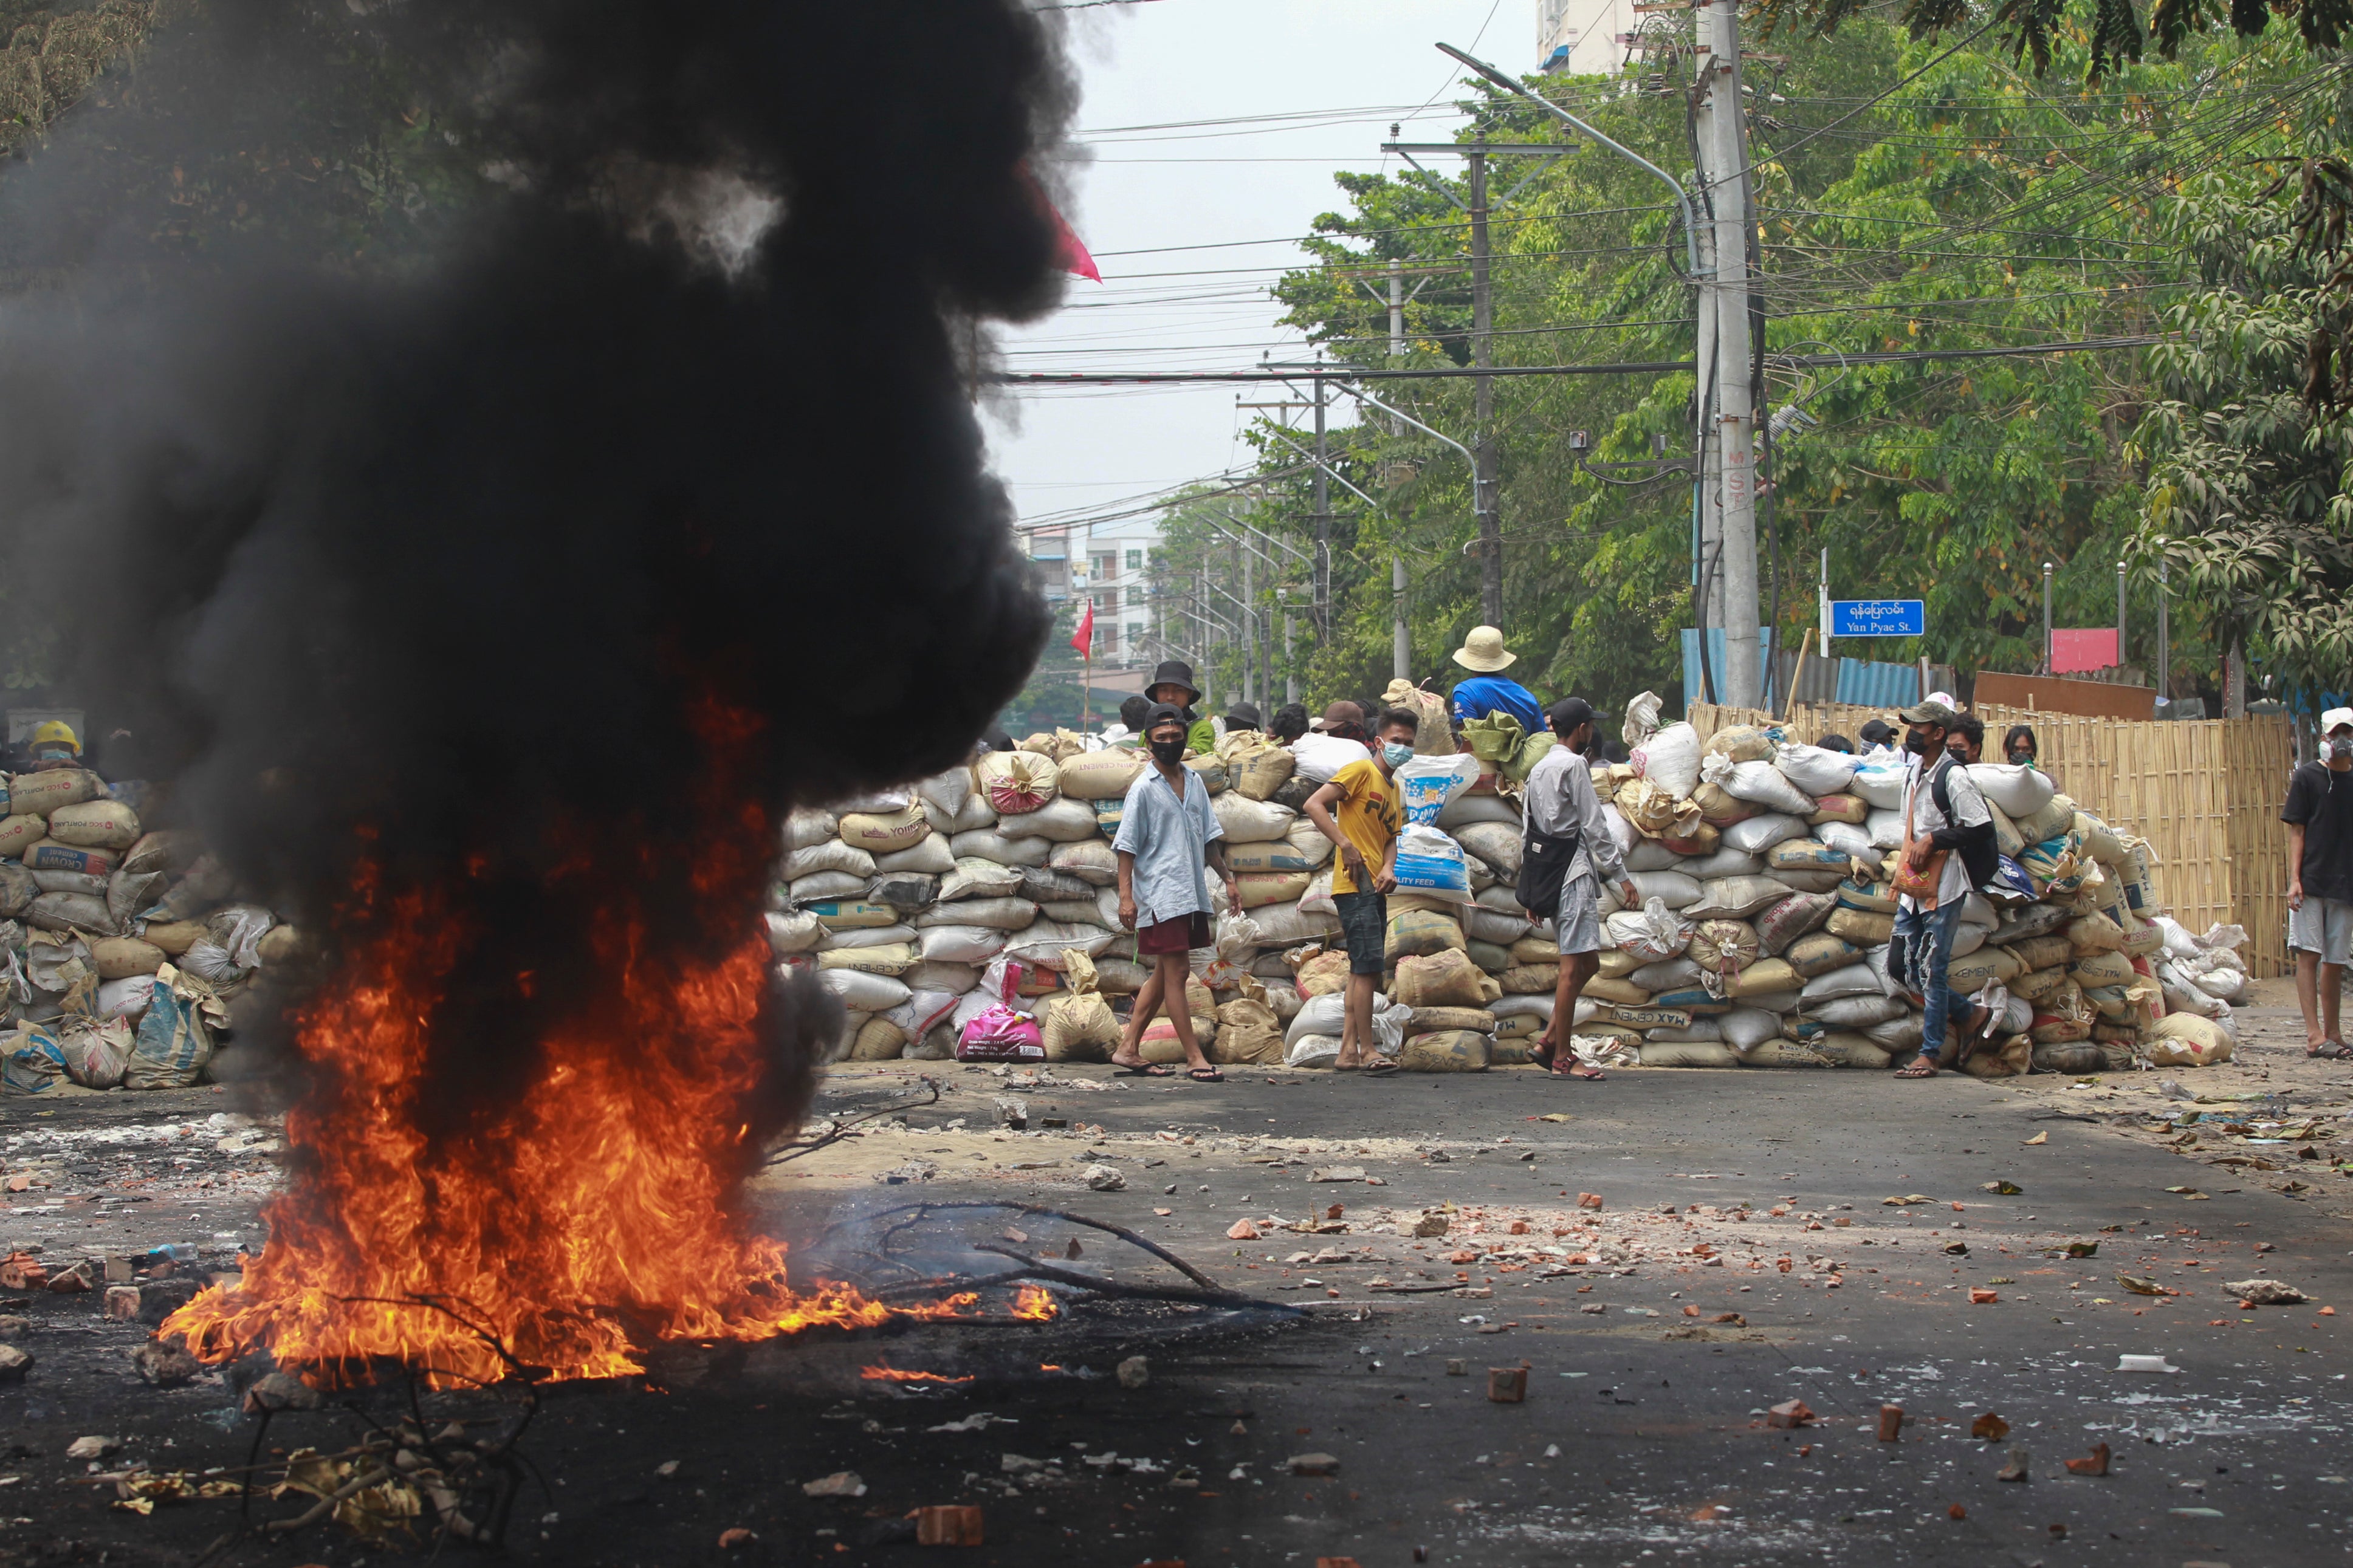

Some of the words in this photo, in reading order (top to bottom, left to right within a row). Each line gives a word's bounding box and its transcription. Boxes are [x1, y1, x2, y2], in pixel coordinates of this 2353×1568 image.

[1850, 603, 1904, 619] ရန်ပြေလမ်း
[1847, 623, 1866, 631] Yan
[1870, 623, 1894, 634] Pyae
[1898, 622, 1911, 631] St.
[1079, 762, 1115, 771] CEMENT
[12, 786, 44, 797] PORTLAND
[1364, 791, 1403, 836] FILA
[49, 849, 78, 859] cement
[41, 856, 83, 870] CROWN
[2138, 864, 2149, 891] MAX
[2078, 963, 2103, 977] CEMEN
[2103, 969, 2121, 978] MAX
[2030, 982, 2052, 997] MAX
[1608, 1010, 1654, 1023] CEMENT
[1657, 1013, 1685, 1026] MAX
[1497, 1021, 1516, 1032] MA
[1413, 1047, 1457, 1067] CEMENT
